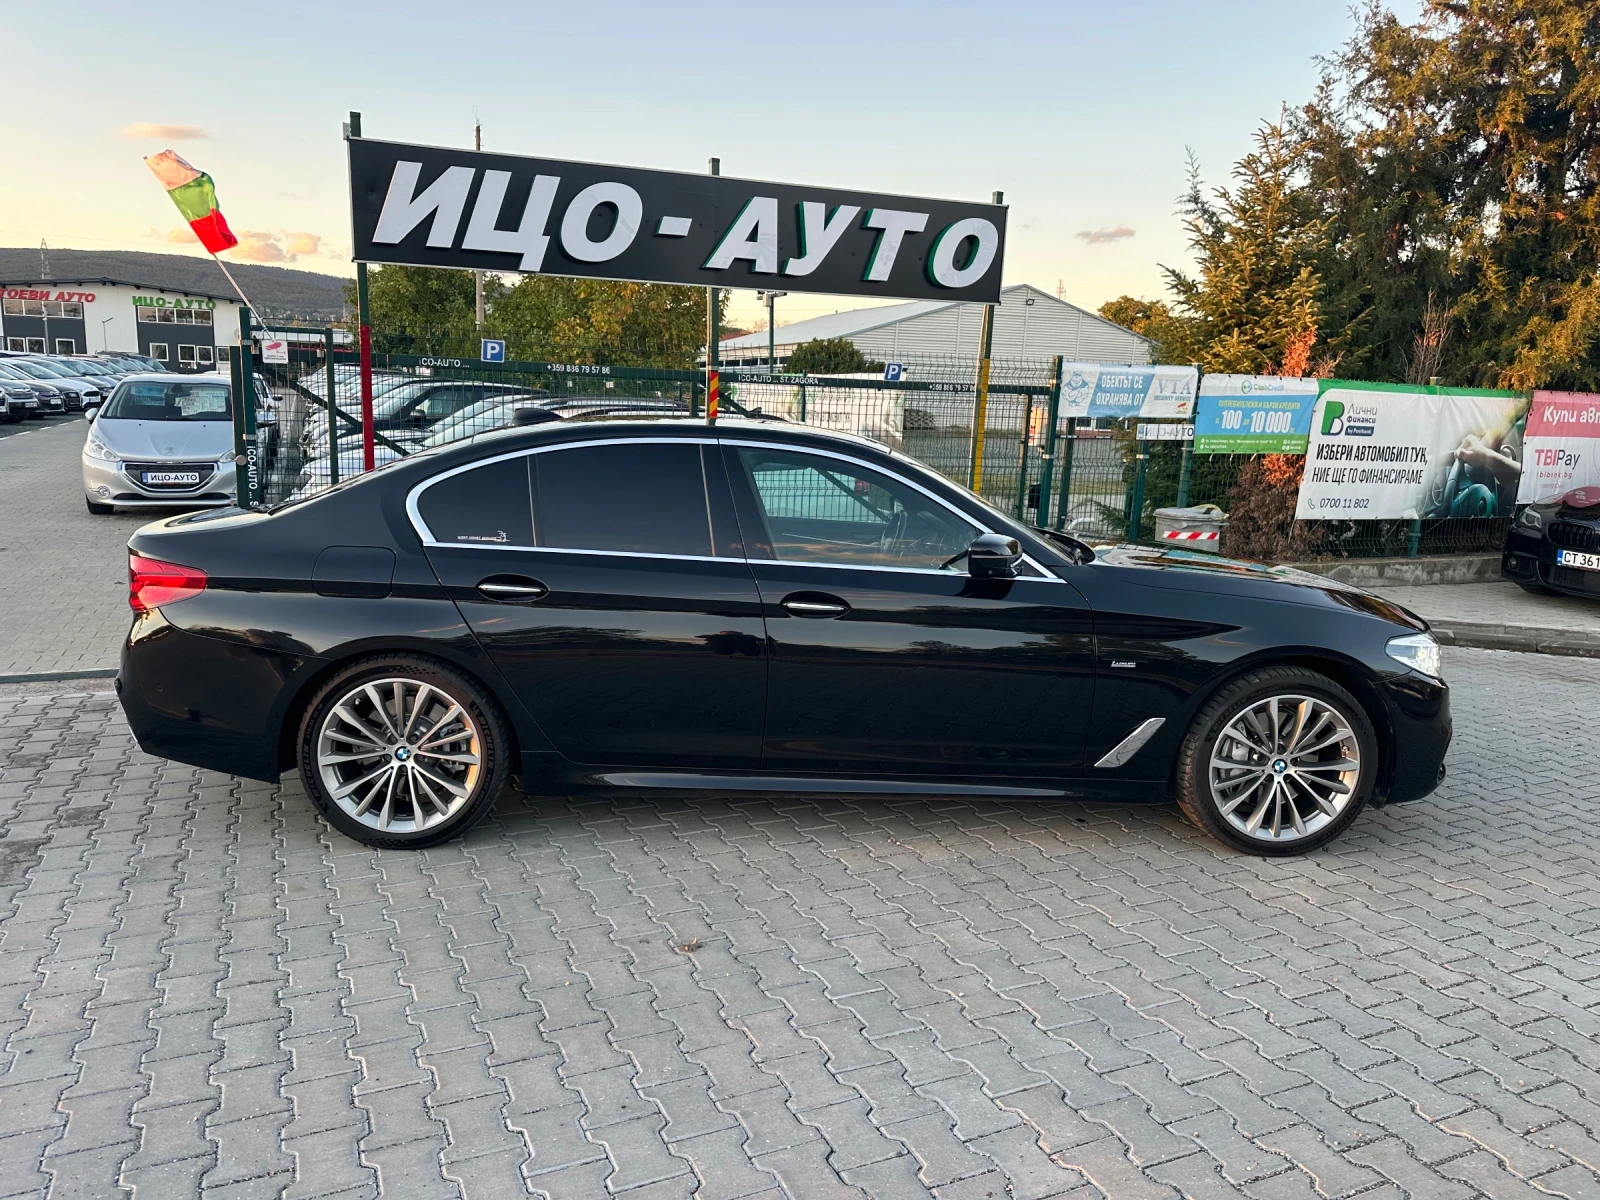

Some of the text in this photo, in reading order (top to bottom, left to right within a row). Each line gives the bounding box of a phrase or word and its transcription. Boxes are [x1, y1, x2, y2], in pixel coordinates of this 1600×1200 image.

[54, 291, 96, 303] АУТО
[132, 295, 216, 310] ИЦО-АУТО
[581, 365, 590, 374] 79
[591, 366, 600, 374] 57
[601, 366, 611, 375] 86
[790, 376, 819, 385] ZAGORA
[1101, 374, 1144, 388] ОБЕКТЪТ СЕ
[1158, 379, 1192, 395] VTA
[962, 384, 969, 392] 57
[1096, 392, 1145, 406] ОХРАНЯВА ОТ
[1347, 403, 1377, 415] Лични
[1543, 405, 1578, 426] Купи
[1221, 409, 1243, 429] 100
[1346, 415, 1376, 423] Финанси
[1316, 444, 1428, 465] ИЗБЕРИ АВТОМОБИЛ ТУК,
[1535, 449, 1580, 470] TBIPay
[150, 473, 198, 483] ИЦО-АУТО
[1312, 467, 1423, 486] НИЕ ЩЕ ГО ФИНАНСИРАМЕ
[1319, 498, 1370, 508] 0700 11 802
